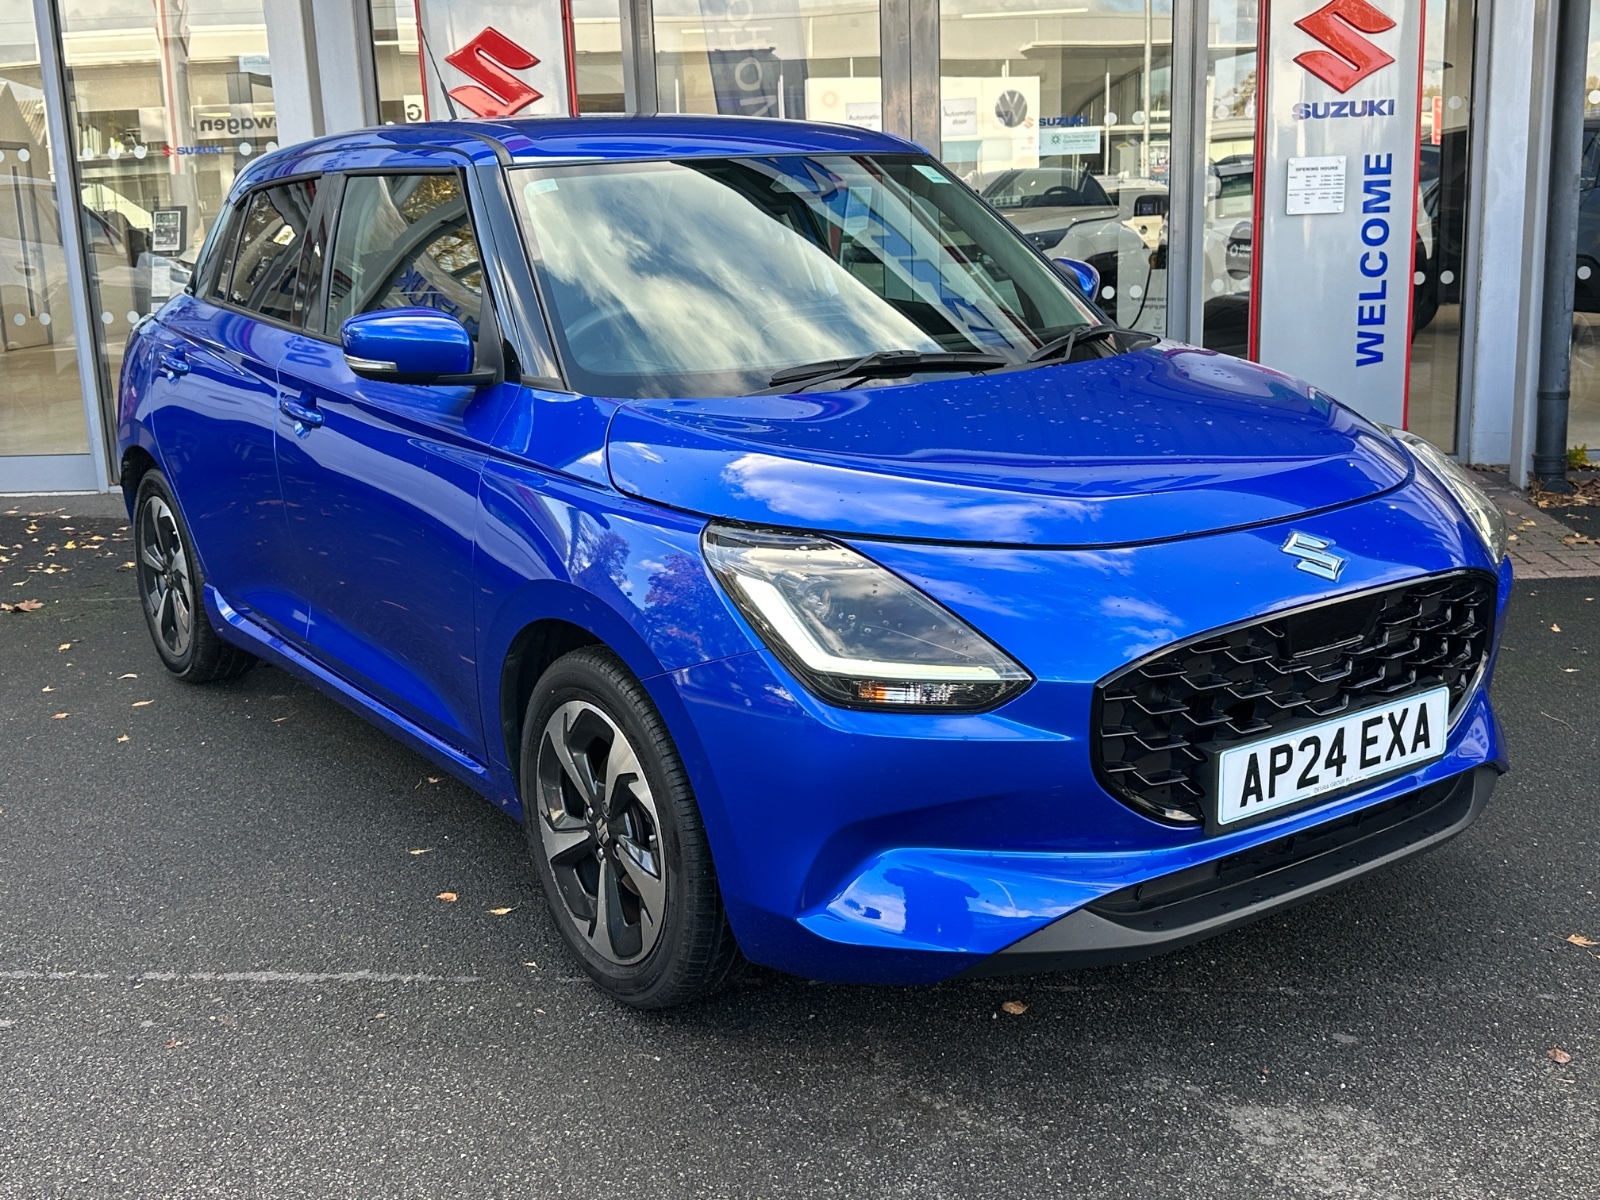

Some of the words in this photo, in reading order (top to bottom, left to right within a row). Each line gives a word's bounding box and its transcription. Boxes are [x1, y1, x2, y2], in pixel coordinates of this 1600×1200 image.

[1292, 99, 1394, 120] SUZUKI
[1039, 116, 1088, 126] SUZUKI
[177, 146, 224, 155] SUZUKI
[1356, 153, 1392, 367] WELCOME
[1240, 726, 1347, 808] AP24
[1359, 702, 1431, 770] EXA
